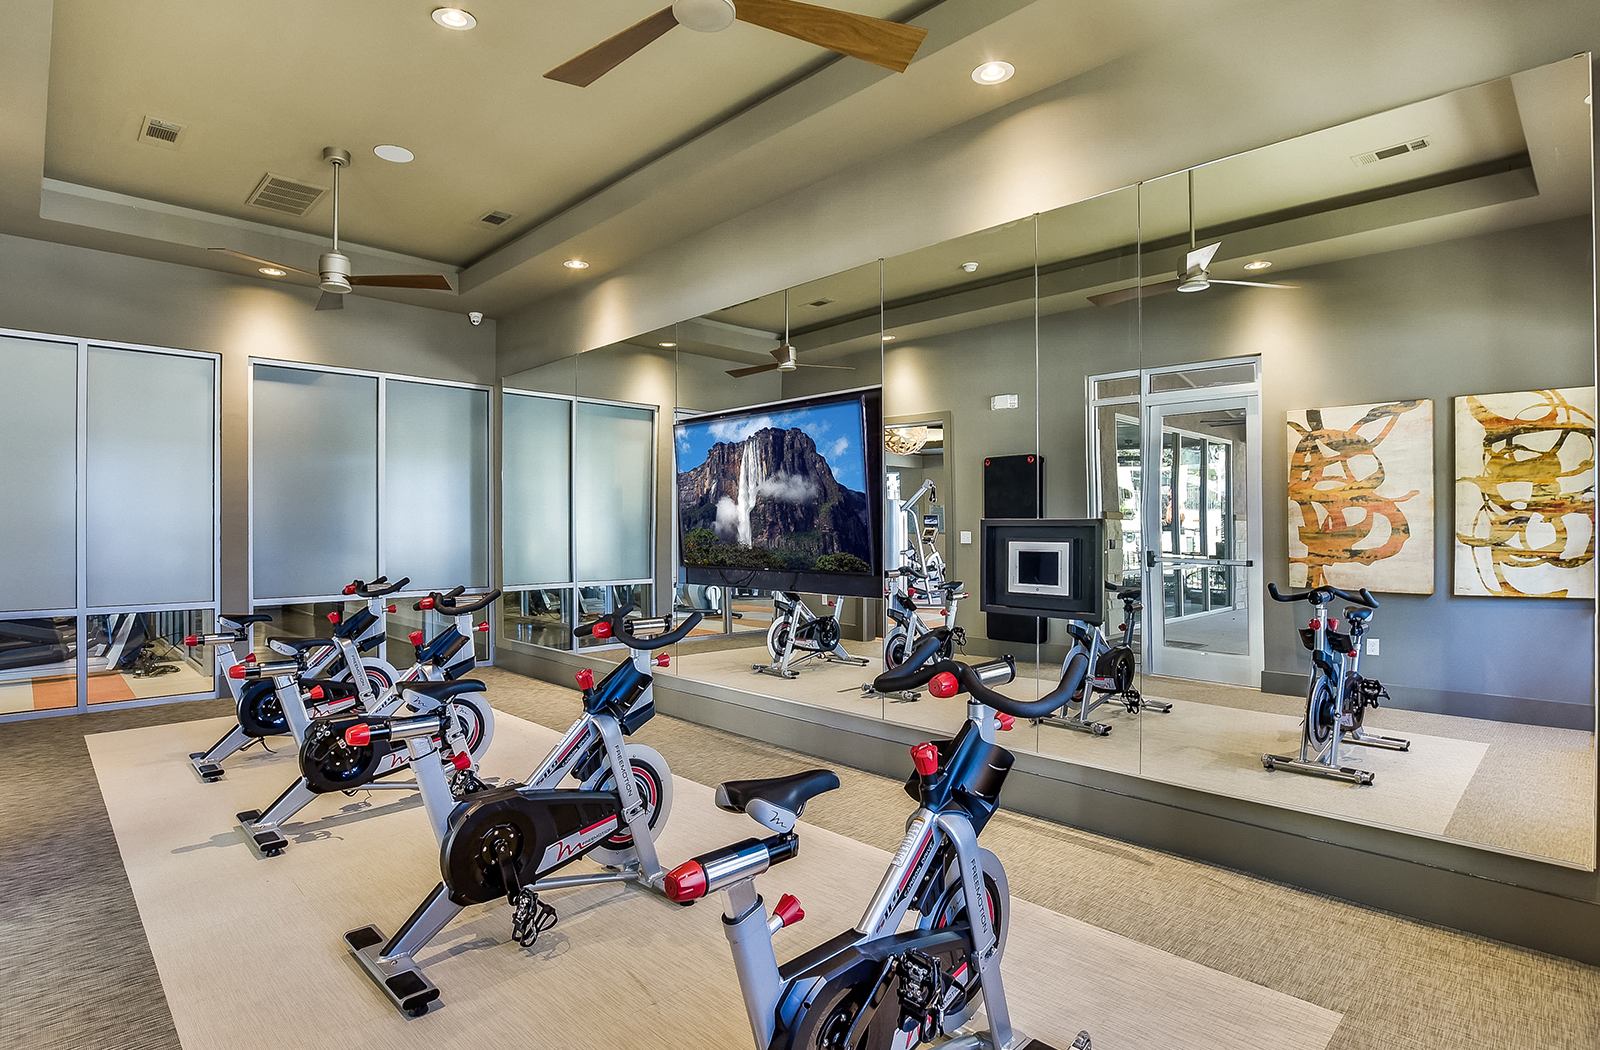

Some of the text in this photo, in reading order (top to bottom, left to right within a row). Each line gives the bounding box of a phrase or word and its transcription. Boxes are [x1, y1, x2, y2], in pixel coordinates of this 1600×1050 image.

[614, 744, 633, 797] FREEMOTION
[903, 864, 922, 898] CARBON
[970, 858, 987, 934] FREEMOTION
